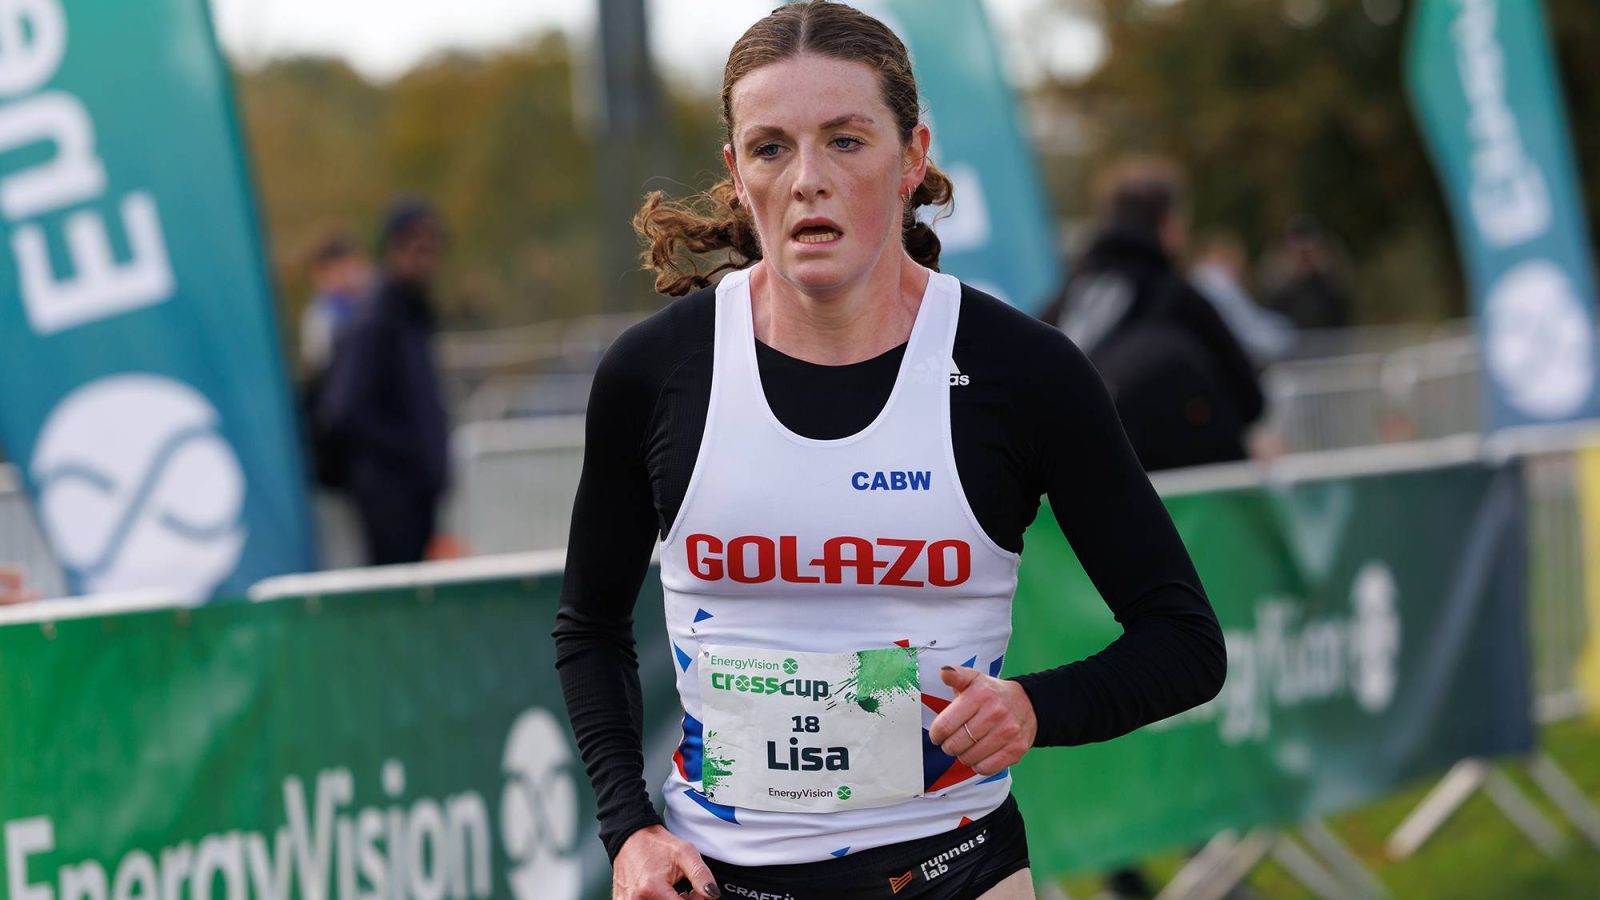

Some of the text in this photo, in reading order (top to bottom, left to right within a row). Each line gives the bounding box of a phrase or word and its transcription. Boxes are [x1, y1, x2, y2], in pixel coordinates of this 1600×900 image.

[851, 471, 931, 490] CABW
[685, 533, 971, 588] GOLAZO
[710, 655, 780, 670] EnergyVision
[791, 715, 820, 733] 18
[767, 737, 849, 771] Lisa
[768, 787, 833, 800] EnergyVision
[922, 863, 949, 881] lab
